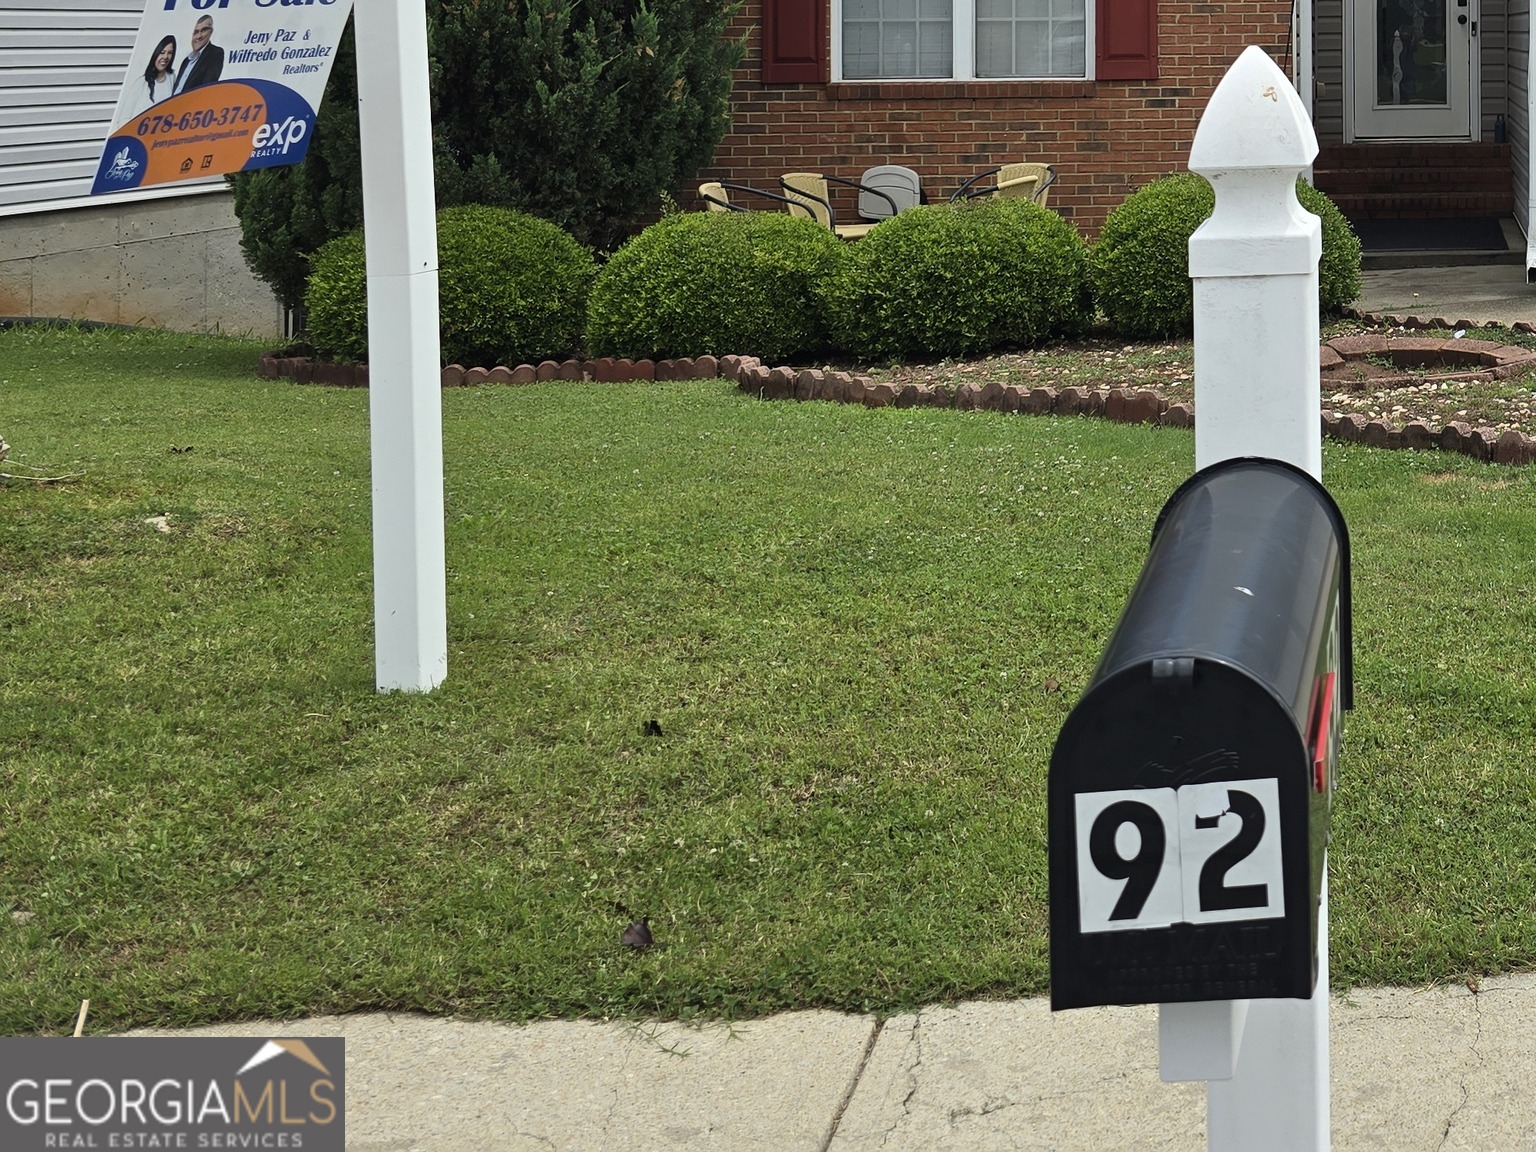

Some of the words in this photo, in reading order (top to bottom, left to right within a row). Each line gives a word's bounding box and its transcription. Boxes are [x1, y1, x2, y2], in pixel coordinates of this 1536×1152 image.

[244, 30, 273, 46] Jeny
[274, 29, 297, 42] Paz
[302, 29, 311, 41] &
[228, 47, 277, 64] Wilfredo
[281, 44, 332, 60] Gonzalez
[137, 103, 264, 136] 678-650-3747
[250, 147, 282, 158] REALTY
[1089, 789, 1269, 921] 92
